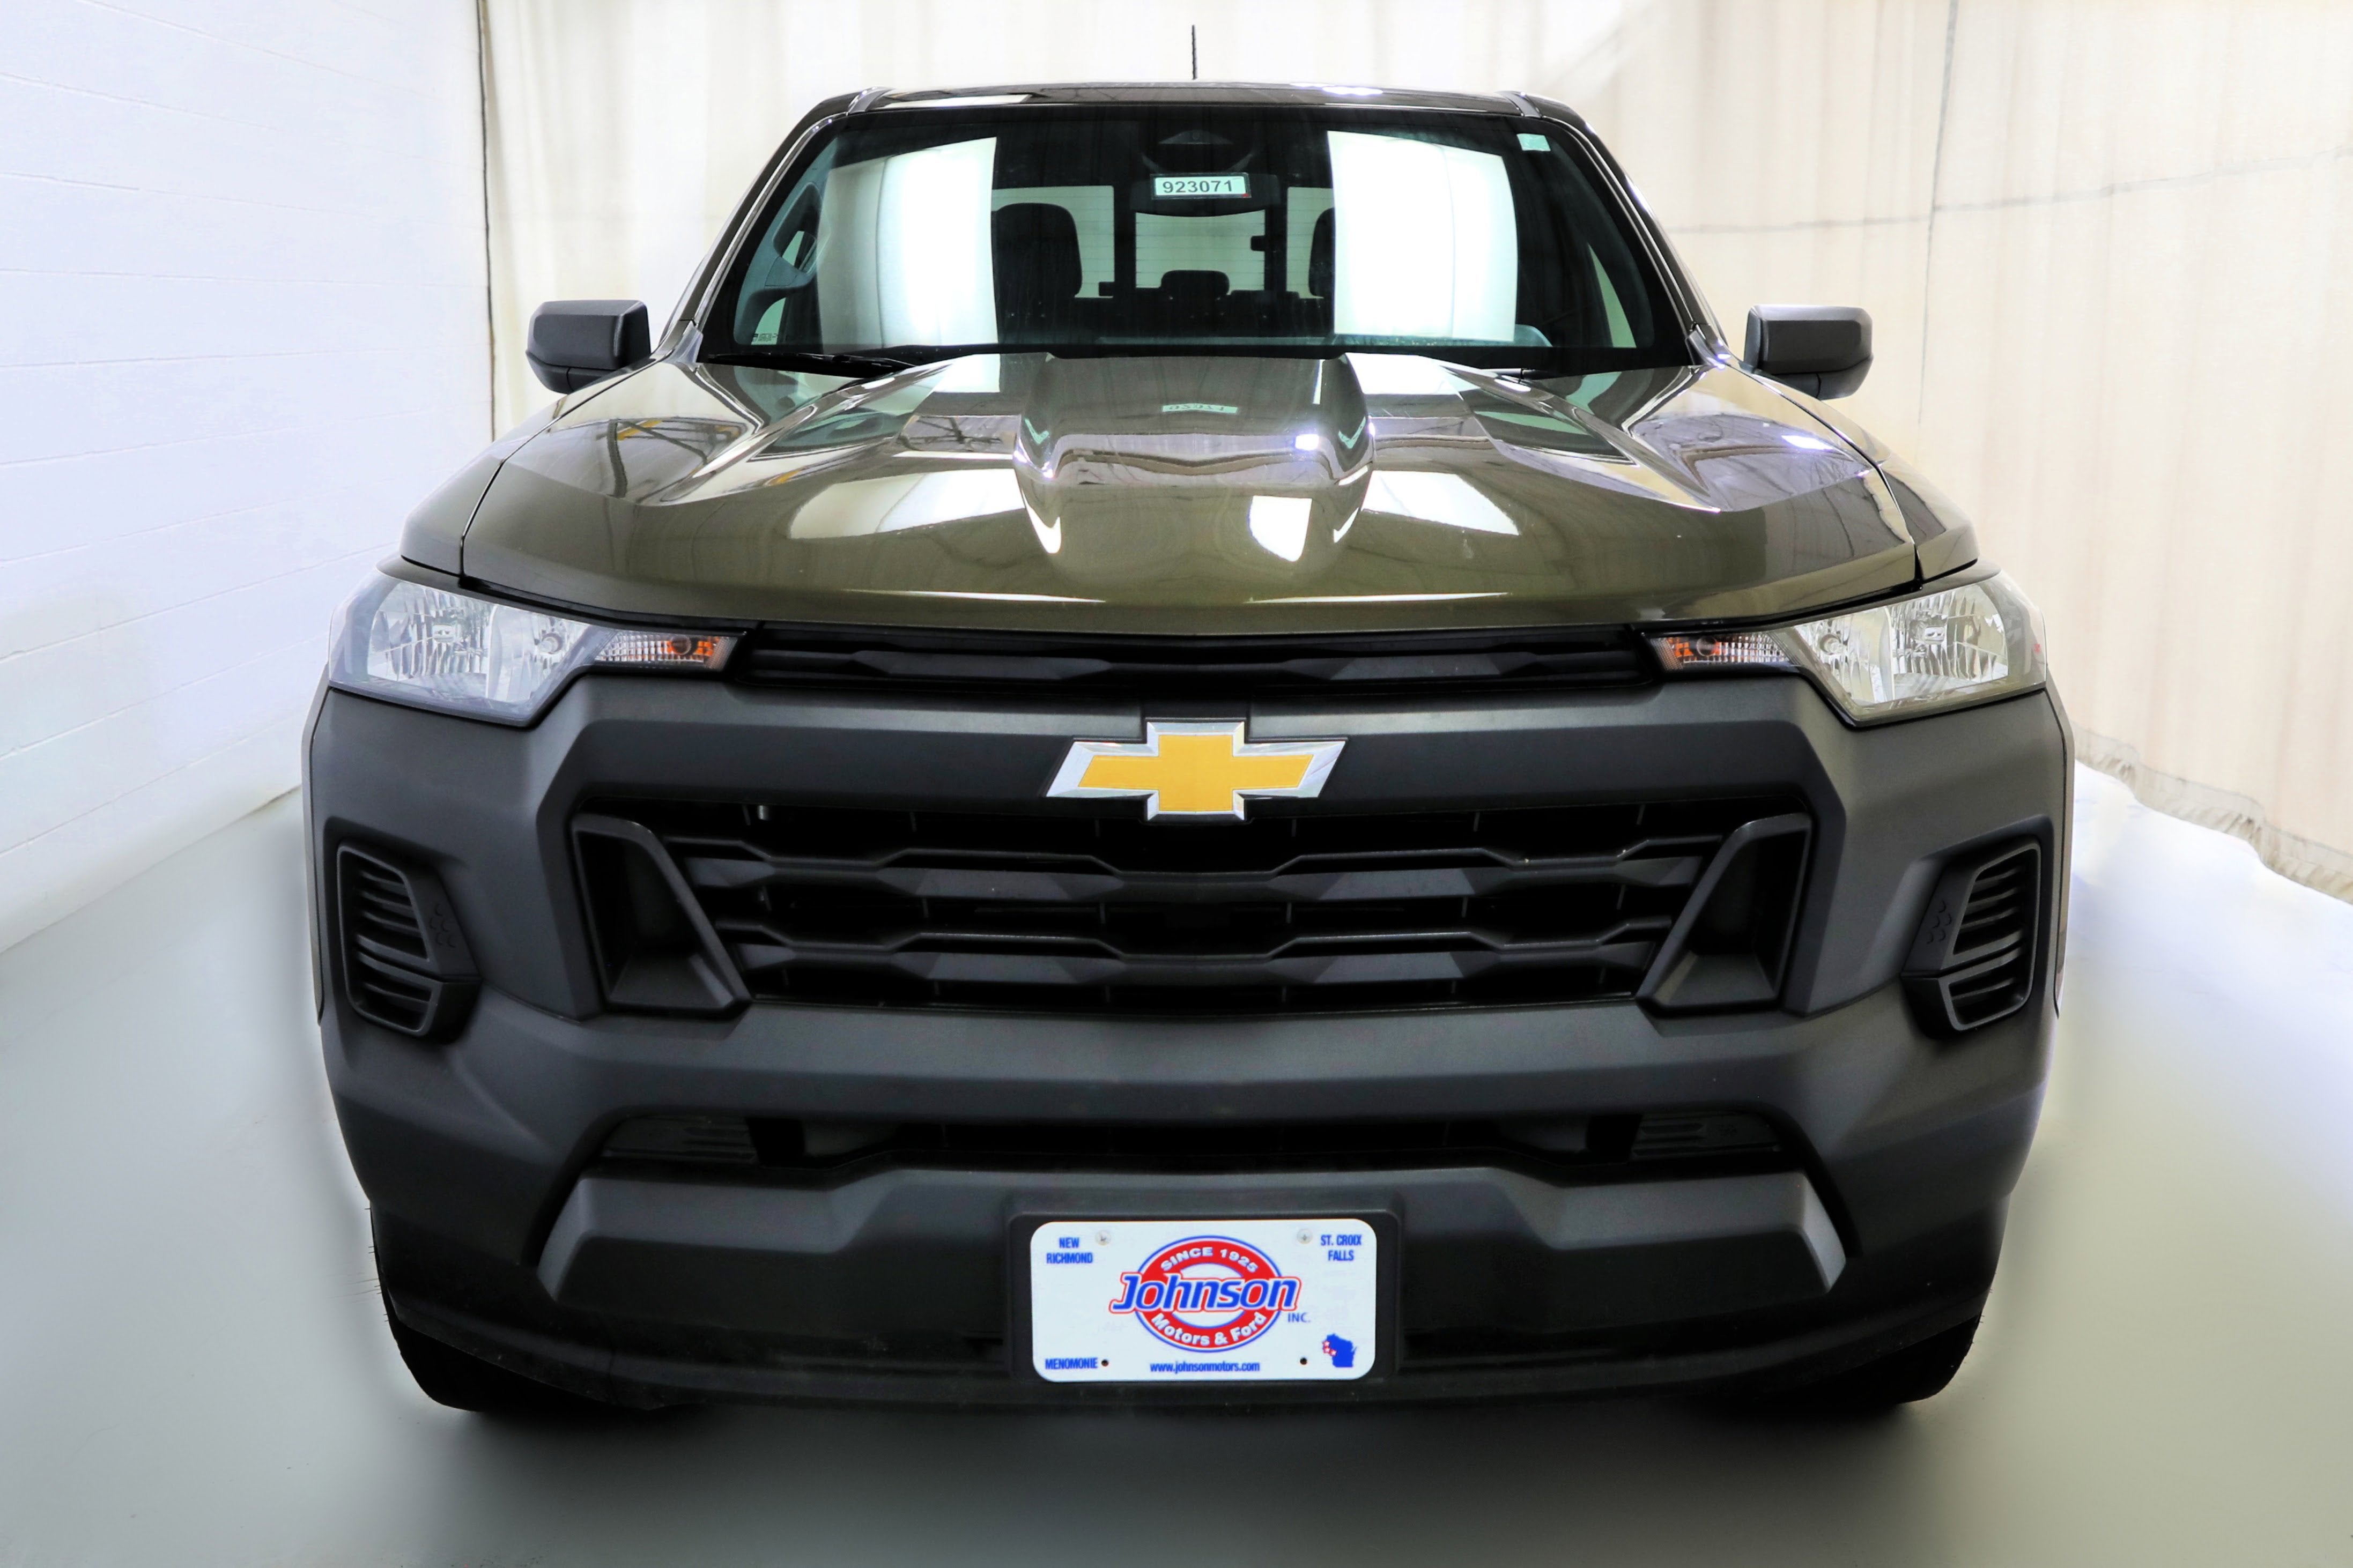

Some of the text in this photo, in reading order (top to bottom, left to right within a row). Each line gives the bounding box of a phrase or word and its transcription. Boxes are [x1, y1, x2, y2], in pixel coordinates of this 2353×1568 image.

[1163, 180, 1233, 193] 923071
[1059, 1237, 1079, 1248] NEW
[1321, 1235, 1362, 1246] ST. CROIX
[1047, 1252, 1093, 1264] RICHMOND
[1161, 1247, 1258, 1273] SINCE 1925
[1328, 1250, 1354, 1261] FALLS
[1112, 1274, 1298, 1310] Johnson
[1288, 1312, 1311, 1323] INC.
[1151, 1312, 1267, 1346] Motors & Ford
[1045, 1358, 1098, 1370] MENOMONIE
[1150, 1361, 1260, 1374] www.johnsonmotors.com
